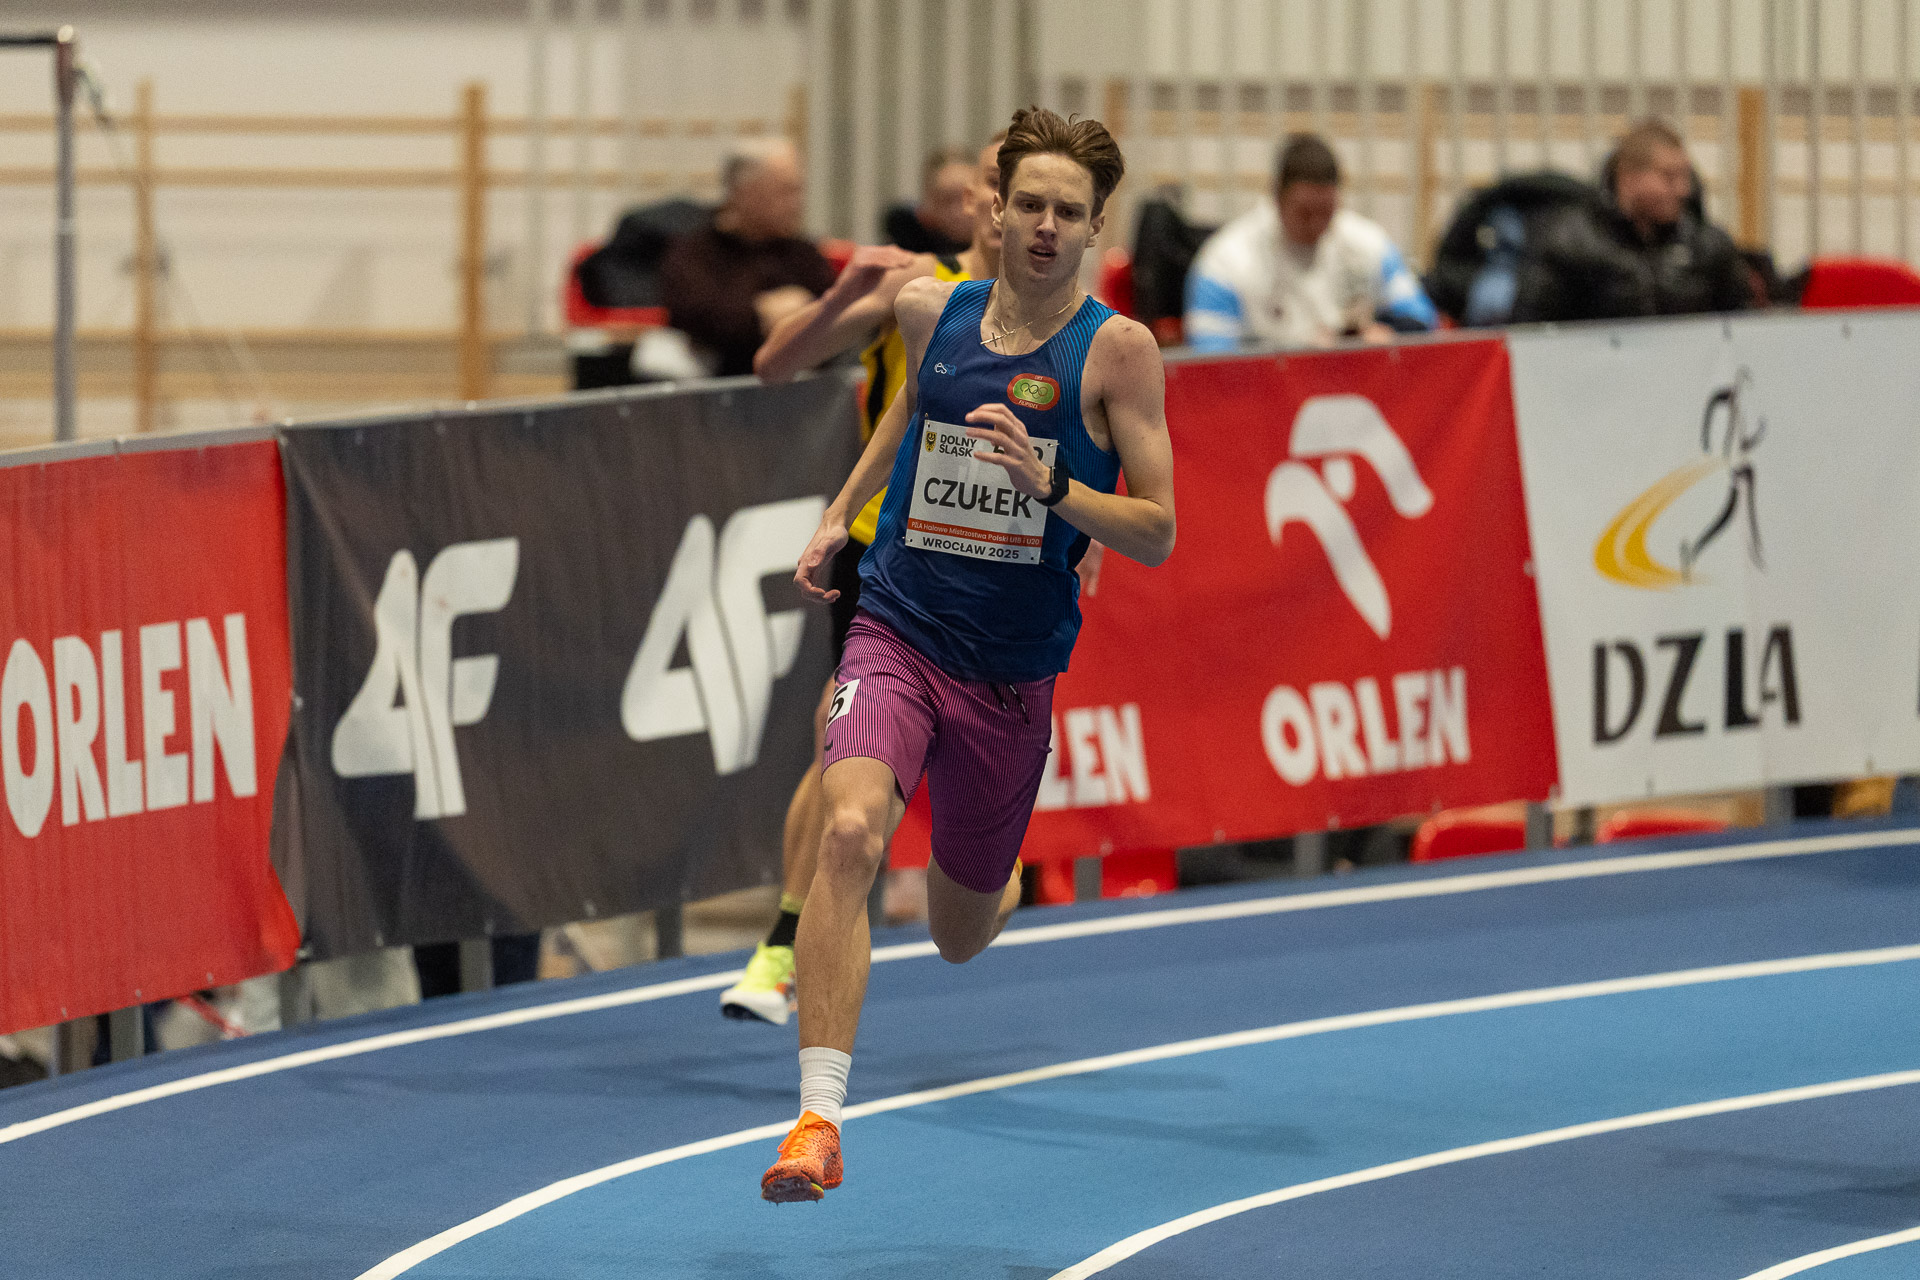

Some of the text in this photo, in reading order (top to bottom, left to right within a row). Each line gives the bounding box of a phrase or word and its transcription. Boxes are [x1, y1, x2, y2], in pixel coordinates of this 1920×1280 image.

[939, 443, 973, 458] ŚLĄSK
[940, 434, 977, 448] DOLNY
[923, 477, 1033, 519] CZUŁEK
[924, 524, 948, 533] Halowe
[949, 527, 987, 540] Mistrzostwa
[988, 533, 1009, 543] Polski
[922, 536, 1019, 559] WROCŁAW 2025
[620, 495, 828, 776] 4F
[332, 537, 519, 820] 4F
[828, 685, 848, 724] 5
[1593, 622, 1801, 745] DZLA
[3, 613, 258, 838] ORLEN
[1034, 702, 1150, 812] LEN
[1261, 666, 1471, 787] ORLEN
